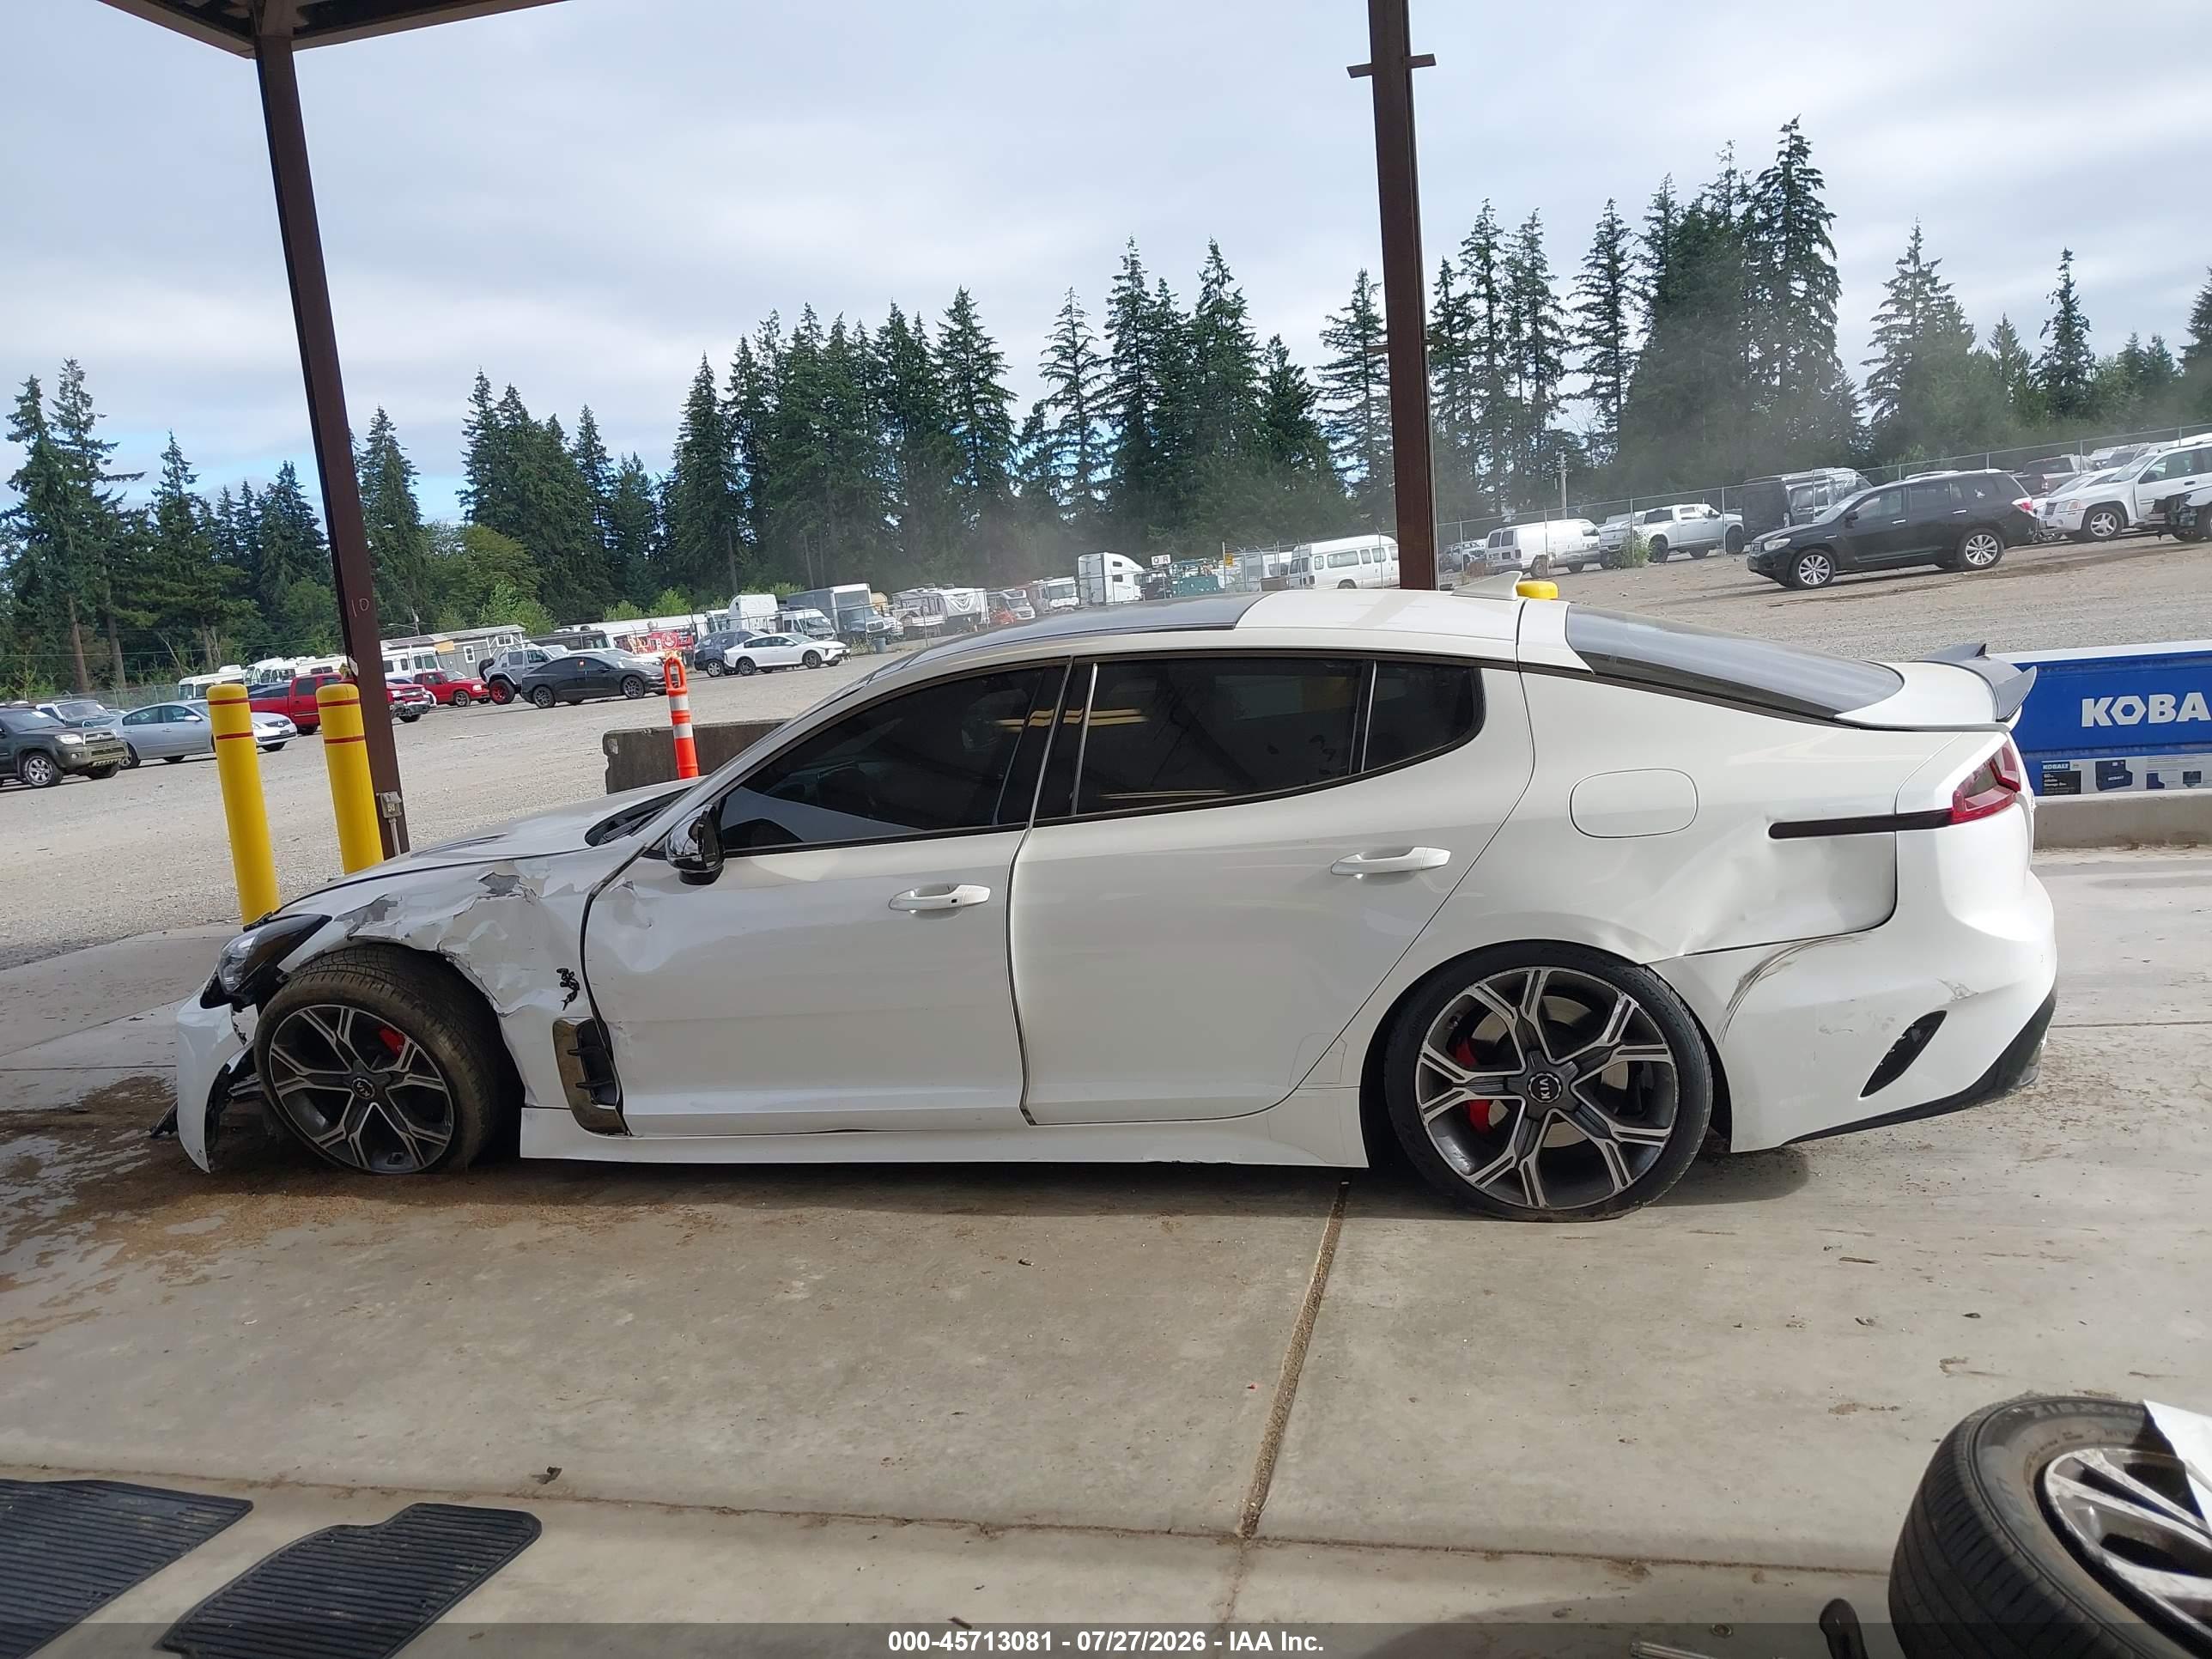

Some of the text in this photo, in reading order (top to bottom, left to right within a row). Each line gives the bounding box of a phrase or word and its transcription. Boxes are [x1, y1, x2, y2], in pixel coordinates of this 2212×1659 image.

[351, 598, 369, 617] 10
[2081, 692, 2212, 727] KOBA
[1540, 1078, 1551, 1099] KIA
